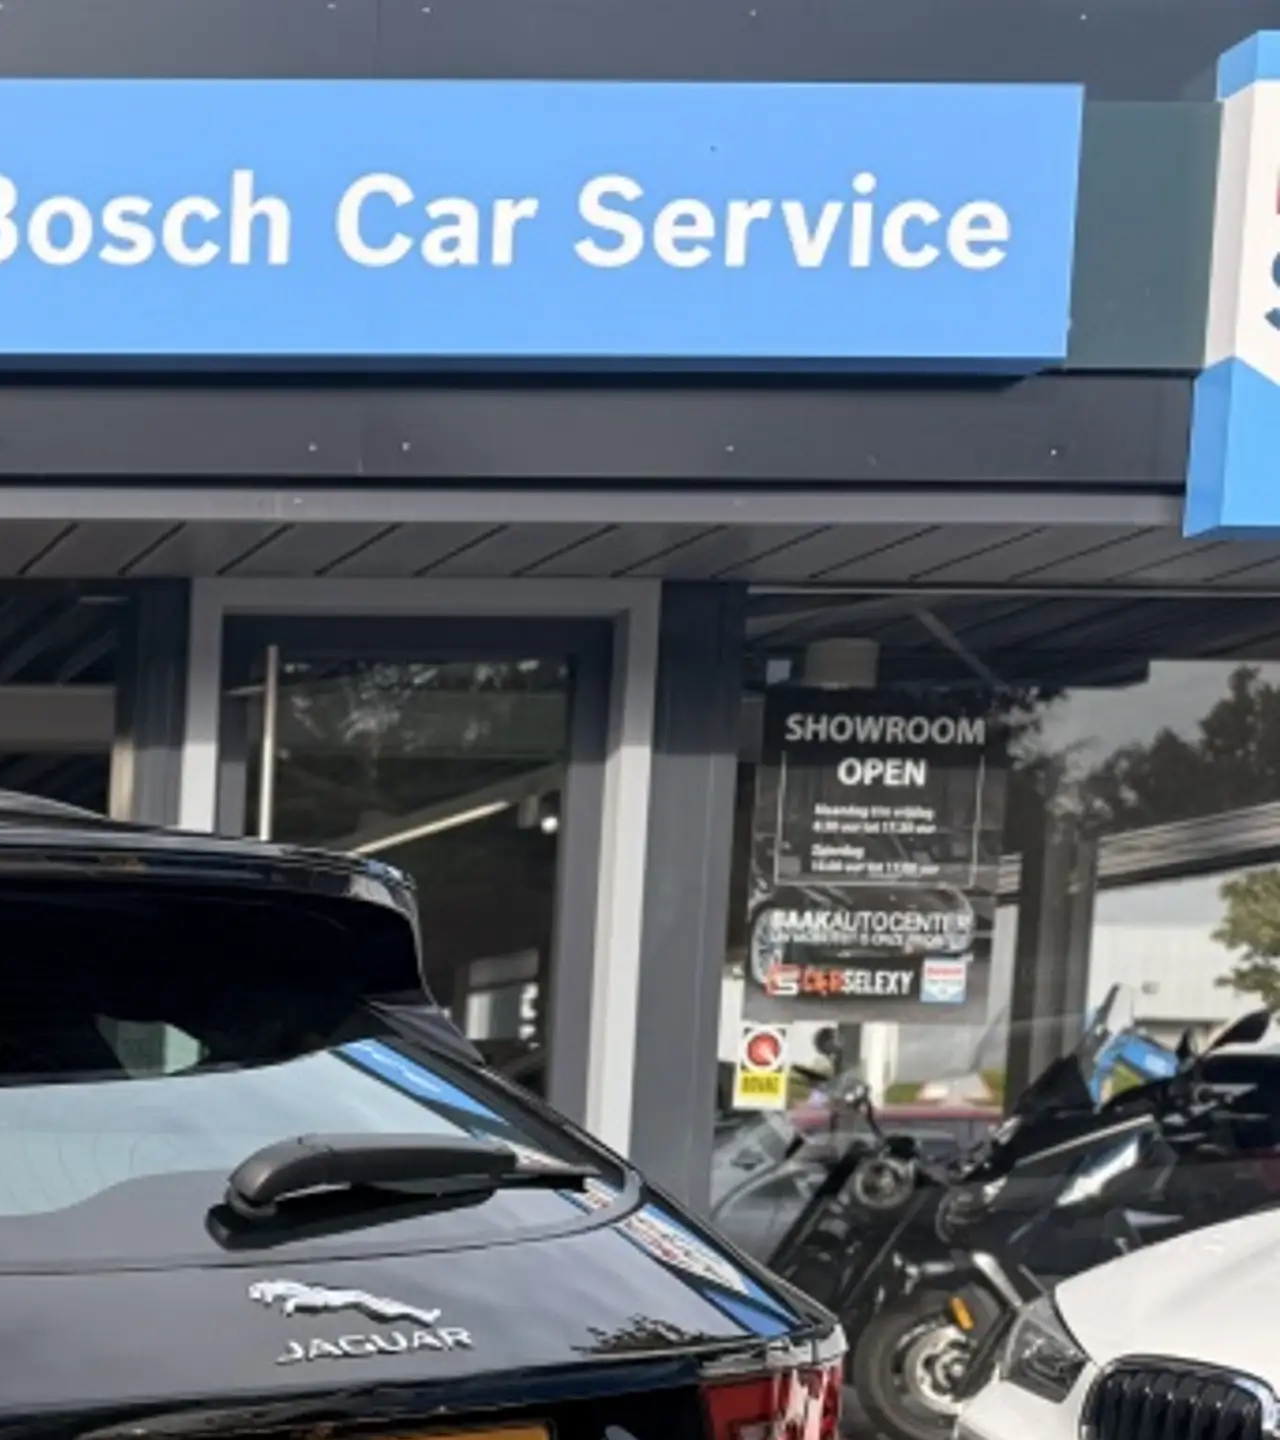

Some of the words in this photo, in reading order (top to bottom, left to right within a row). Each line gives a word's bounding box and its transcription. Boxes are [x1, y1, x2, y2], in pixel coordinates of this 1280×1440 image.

[336, 173, 539, 267] Car
[574, 172, 1011, 268] Service
[784, 712, 987, 745] SHOWROOM
[836, 757, 927, 787] OPEN
[275, 1326, 474, 1366] JAGUAR
